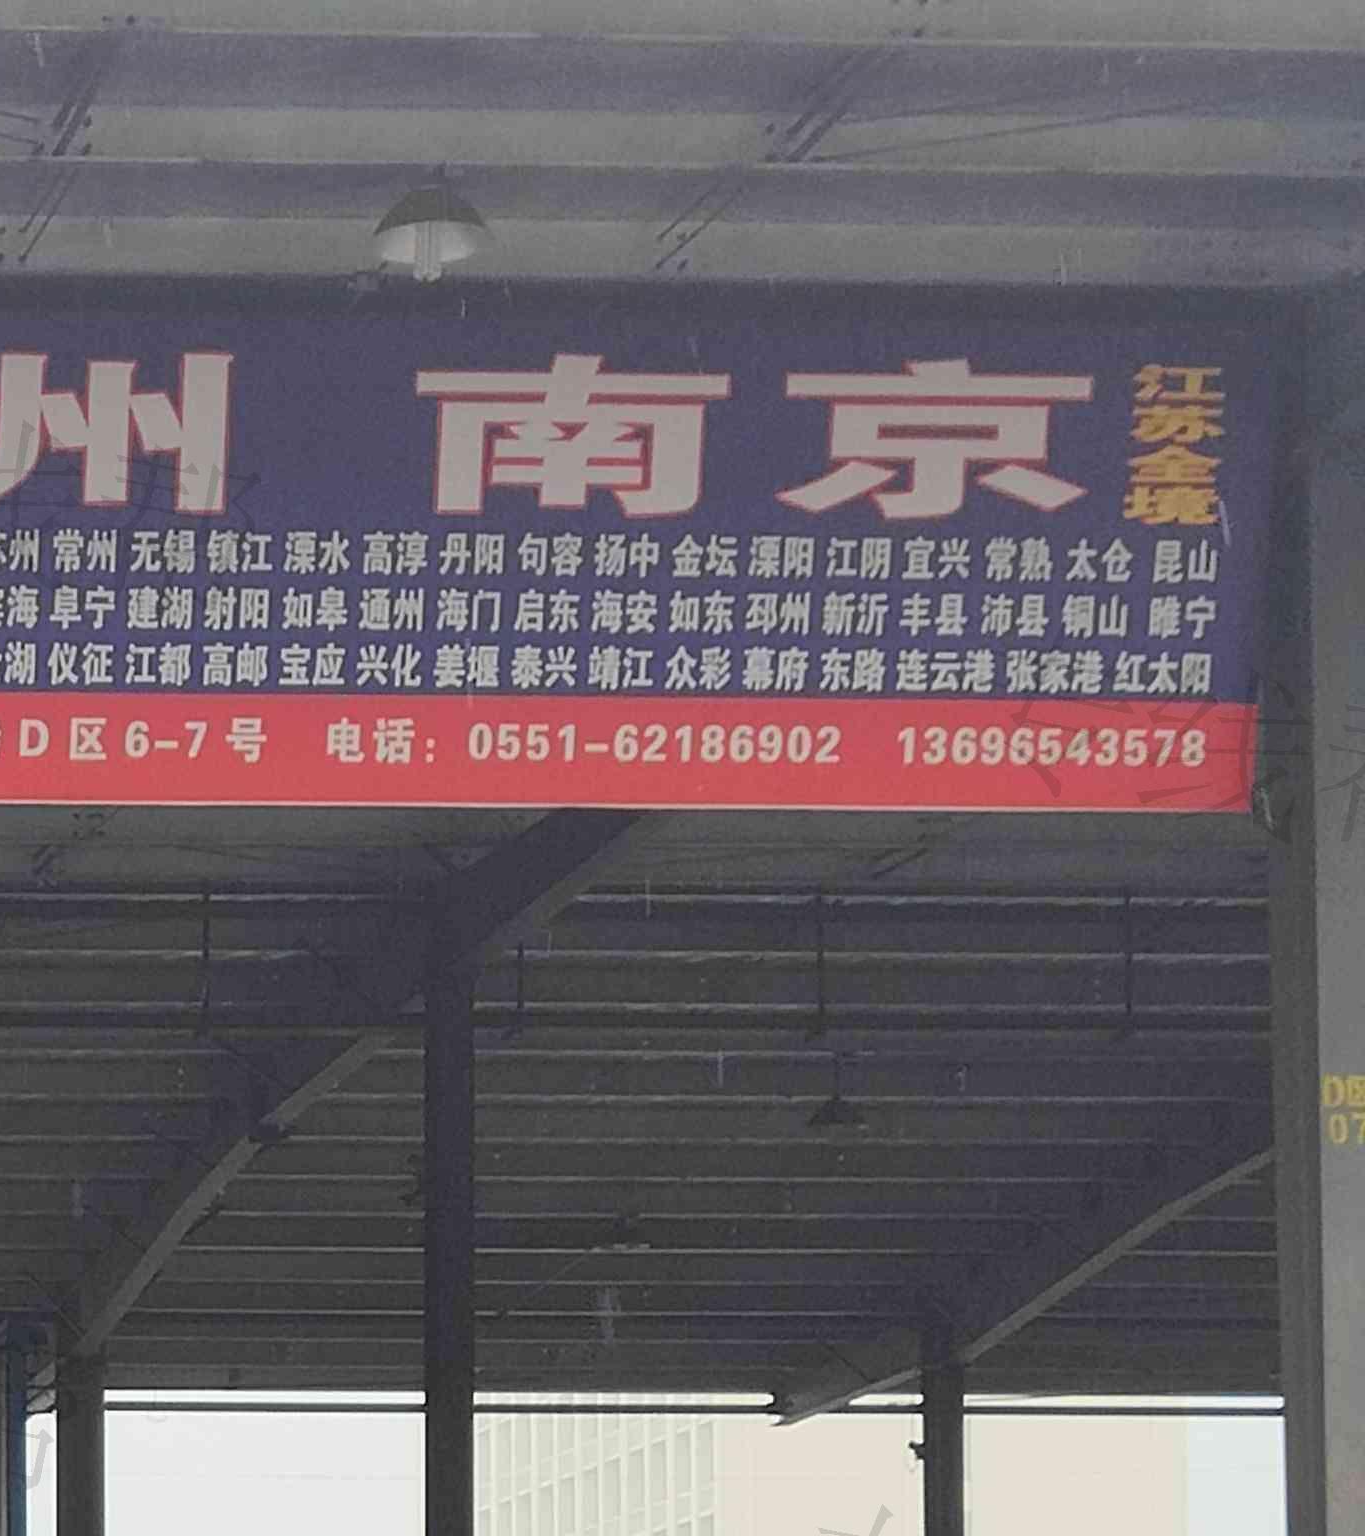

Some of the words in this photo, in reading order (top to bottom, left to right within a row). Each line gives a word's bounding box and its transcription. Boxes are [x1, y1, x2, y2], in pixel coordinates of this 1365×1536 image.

[413, 352, 1095, 520] 南京
[1122, 362, 1228, 528] 江苏全境
[53, 528, 117, 573] 常州
[130, 529, 195, 574] 无锡
[207, 529, 273, 574] 镇江
[363, 531, 429, 576] 高淳
[439, 533, 505, 575] 丹阳
[517, 532, 583, 577] 句容
[594, 533, 660, 578] 扬中
[672, 534, 738, 577] 金坛
[826, 537, 892, 579] 江阴
[902, 535, 970, 579] 宜兴
[985, 537, 1052, 582] 常熟
[1066, 538, 1133, 582] 太仓
[1153, 539, 1217, 583] 昆山
[49, 585, 116, 630] 阜宁
[127, 585, 193, 630] 建湖
[204, 586, 270, 631] 射阳
[358, 587, 424, 632] 通州
[436, 587, 501, 633] 海门
[513, 588, 580, 633] 启东
[591, 589, 658, 634] 海安
[668, 589, 735, 635] 如东
[745, 591, 811, 636] 邳州
[822, 591, 889, 637] 新沂
[899, 592, 968, 636] 丰县
[980, 593, 1049, 637] 沛县
[47, 642, 114, 686] 仪征
[125, 641, 192, 687] 江都
[202, 641, 268, 687] 高邮
[278, 642, 346, 686] 宝应
[356, 643, 422, 688] 兴化
[510, 644, 578, 690] 泰兴
[819, 647, 886, 692] 东路
[896, 648, 995, 693] 连云港
[1006, 649, 1104, 694] 张家港
[1113, 650, 1211, 694] 红太阳
[468, 722, 842, 764] 0551-62186902
[896, 728, 1208, 769] 13696543578
